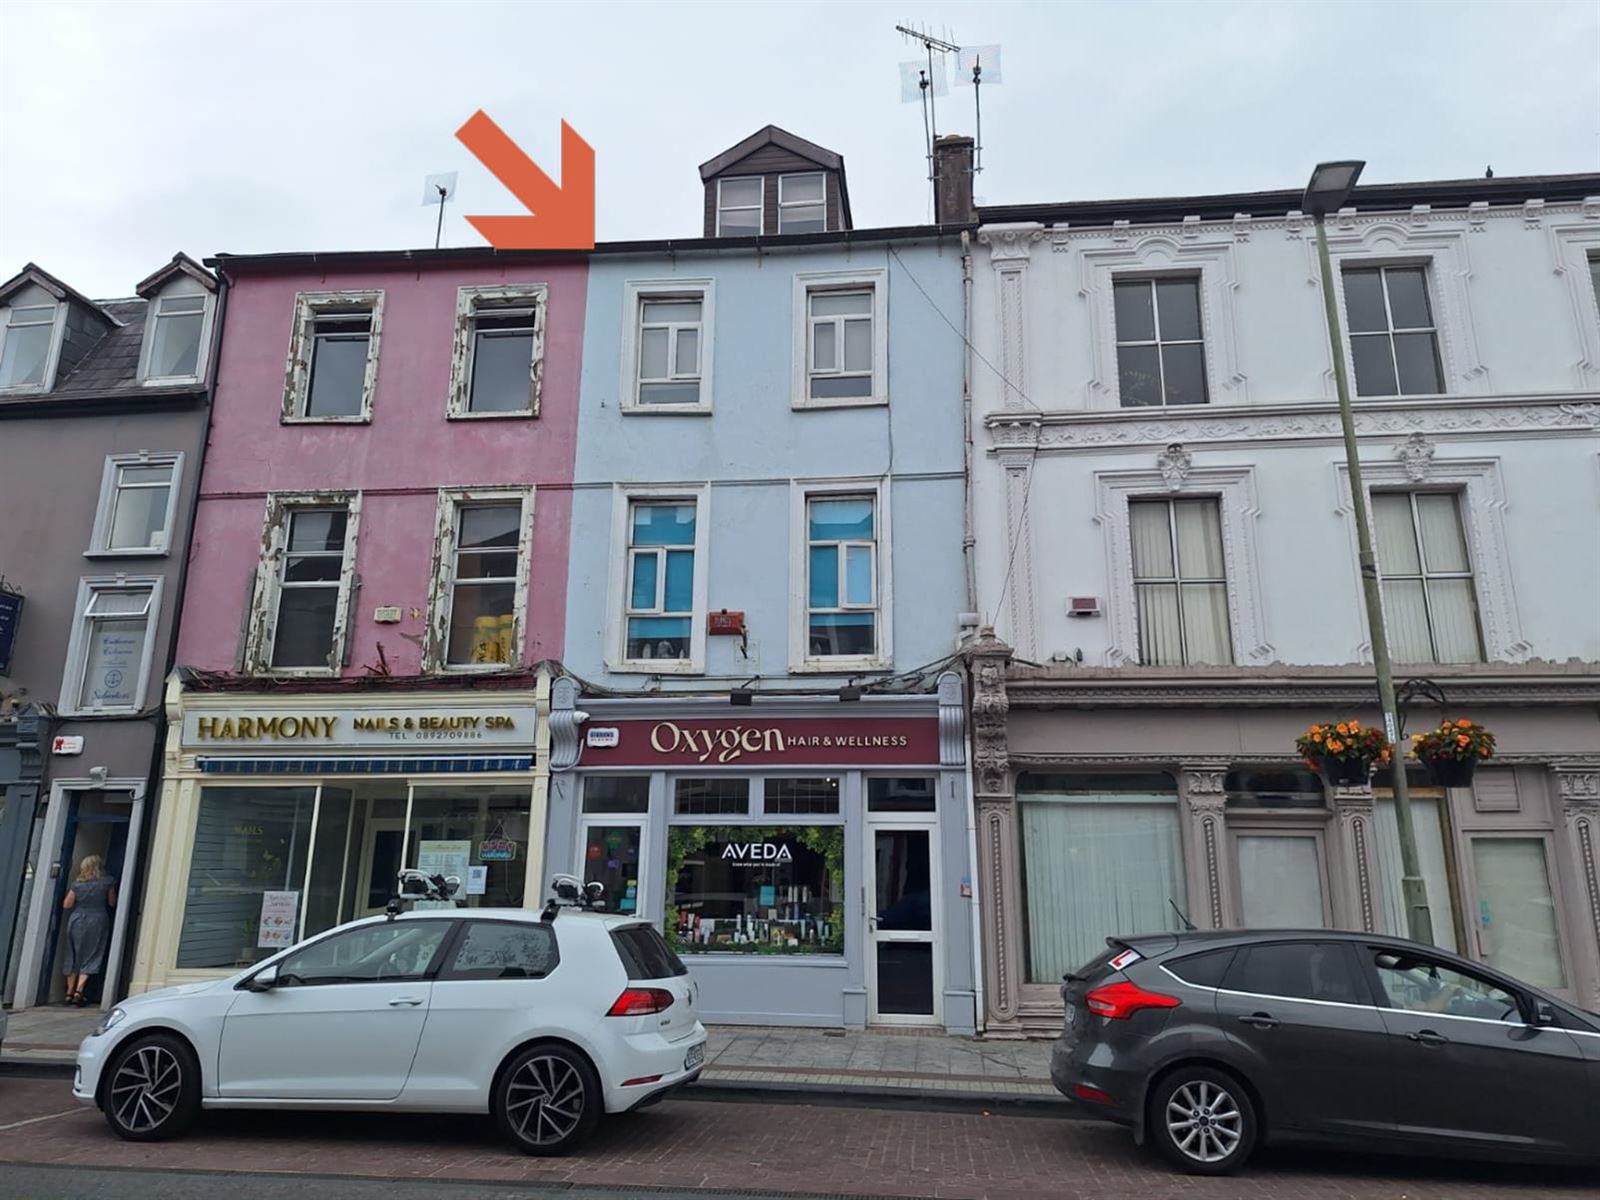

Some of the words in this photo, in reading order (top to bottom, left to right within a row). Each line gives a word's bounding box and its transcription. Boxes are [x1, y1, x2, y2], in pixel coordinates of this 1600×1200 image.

[198, 716, 337, 739] HARMONY
[353, 718, 399, 730] NAILS
[403, 717, 413, 729] &
[419, 717, 480, 729] BEAUTY
[485, 716, 515, 729] SPA
[389, 732, 408, 740] TEL
[651, 721, 785, 763] Oxygen
[787, 736, 820, 746] HAIR
[823, 736, 832, 746] &
[835, 736, 908, 746] WELLNESS
[721, 843, 793, 860] AVEDA
